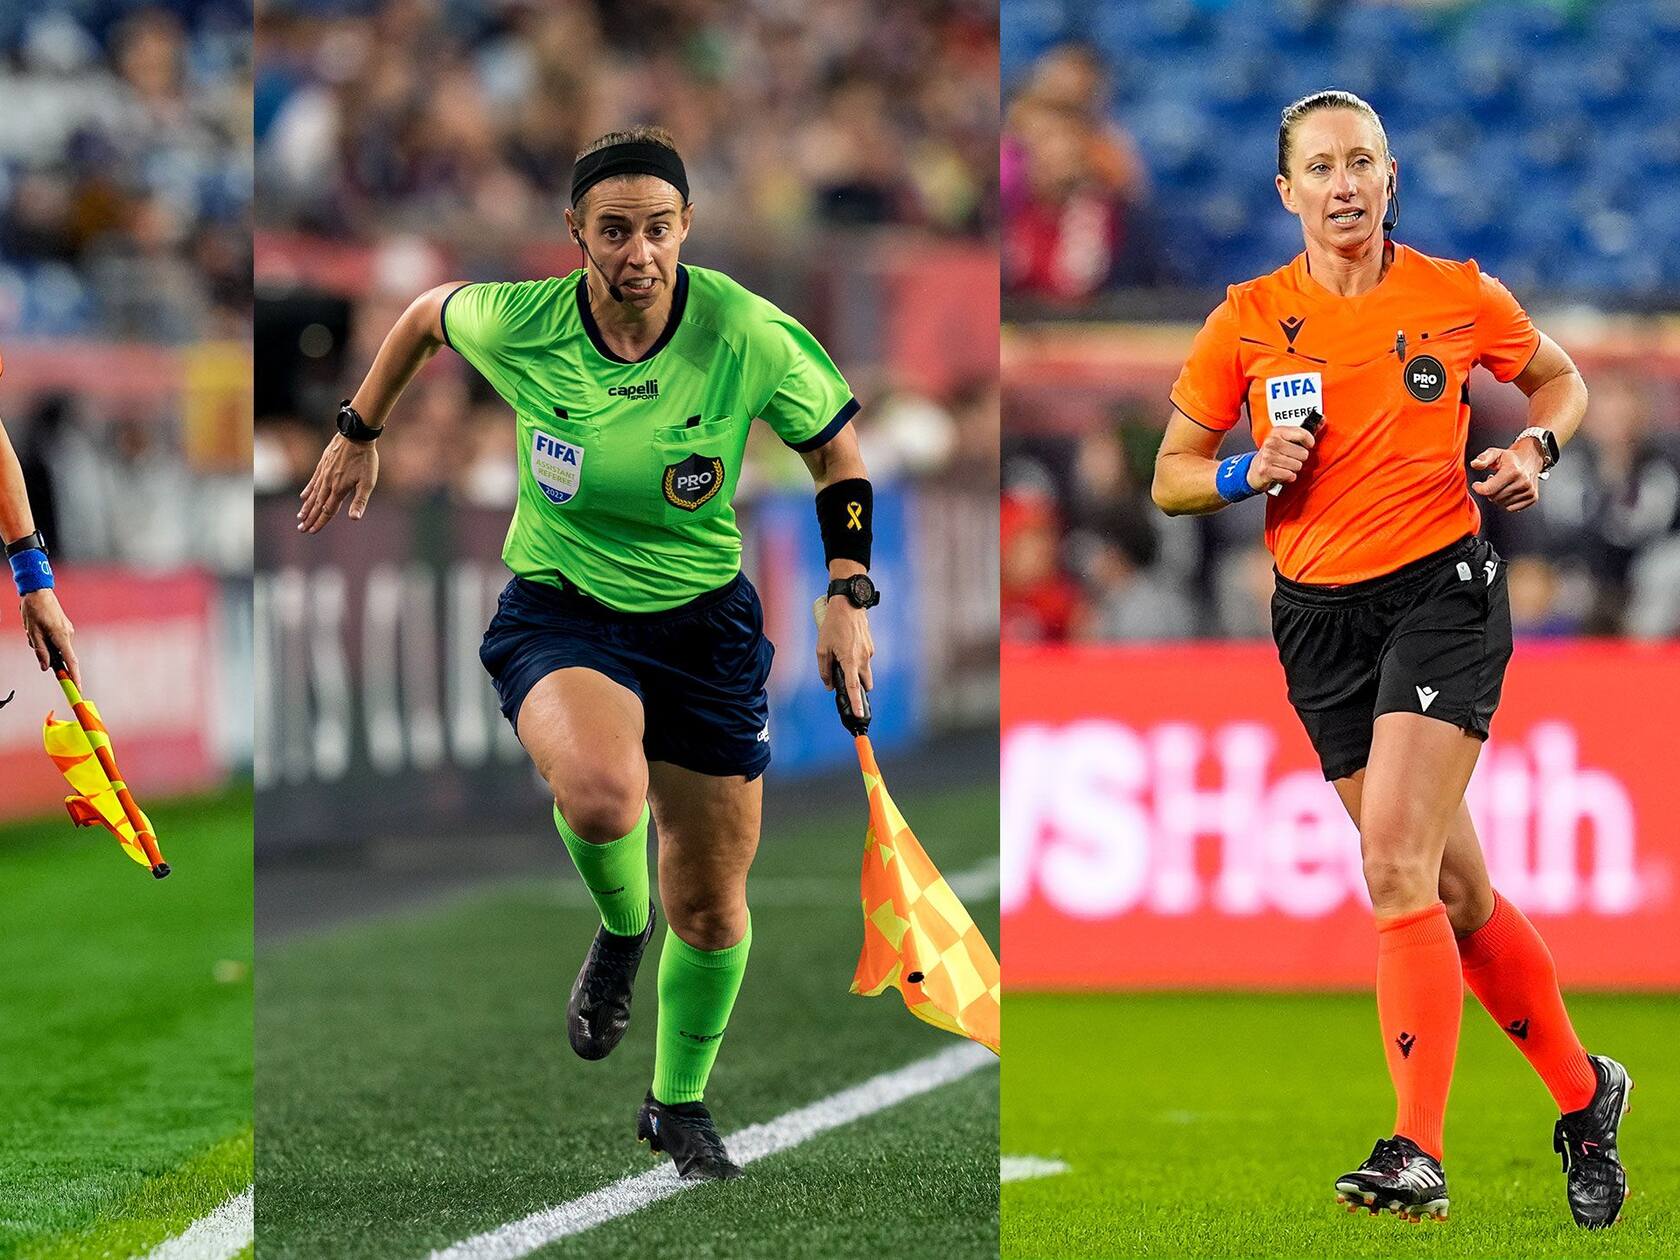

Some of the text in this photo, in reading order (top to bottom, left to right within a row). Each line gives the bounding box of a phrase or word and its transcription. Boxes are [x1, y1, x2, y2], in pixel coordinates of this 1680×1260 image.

[1271, 378, 1316, 399] FIFA
[1413, 373, 1438, 385] PRO
[608, 379, 659, 399] capelli
[536, 434, 577, 466] FIFA
[536, 459, 575, 479] ASSISTANT
[538, 468, 573, 486] REFEREE
[677, 472, 712, 489] PRO
[545, 486, 564, 500] 2022
